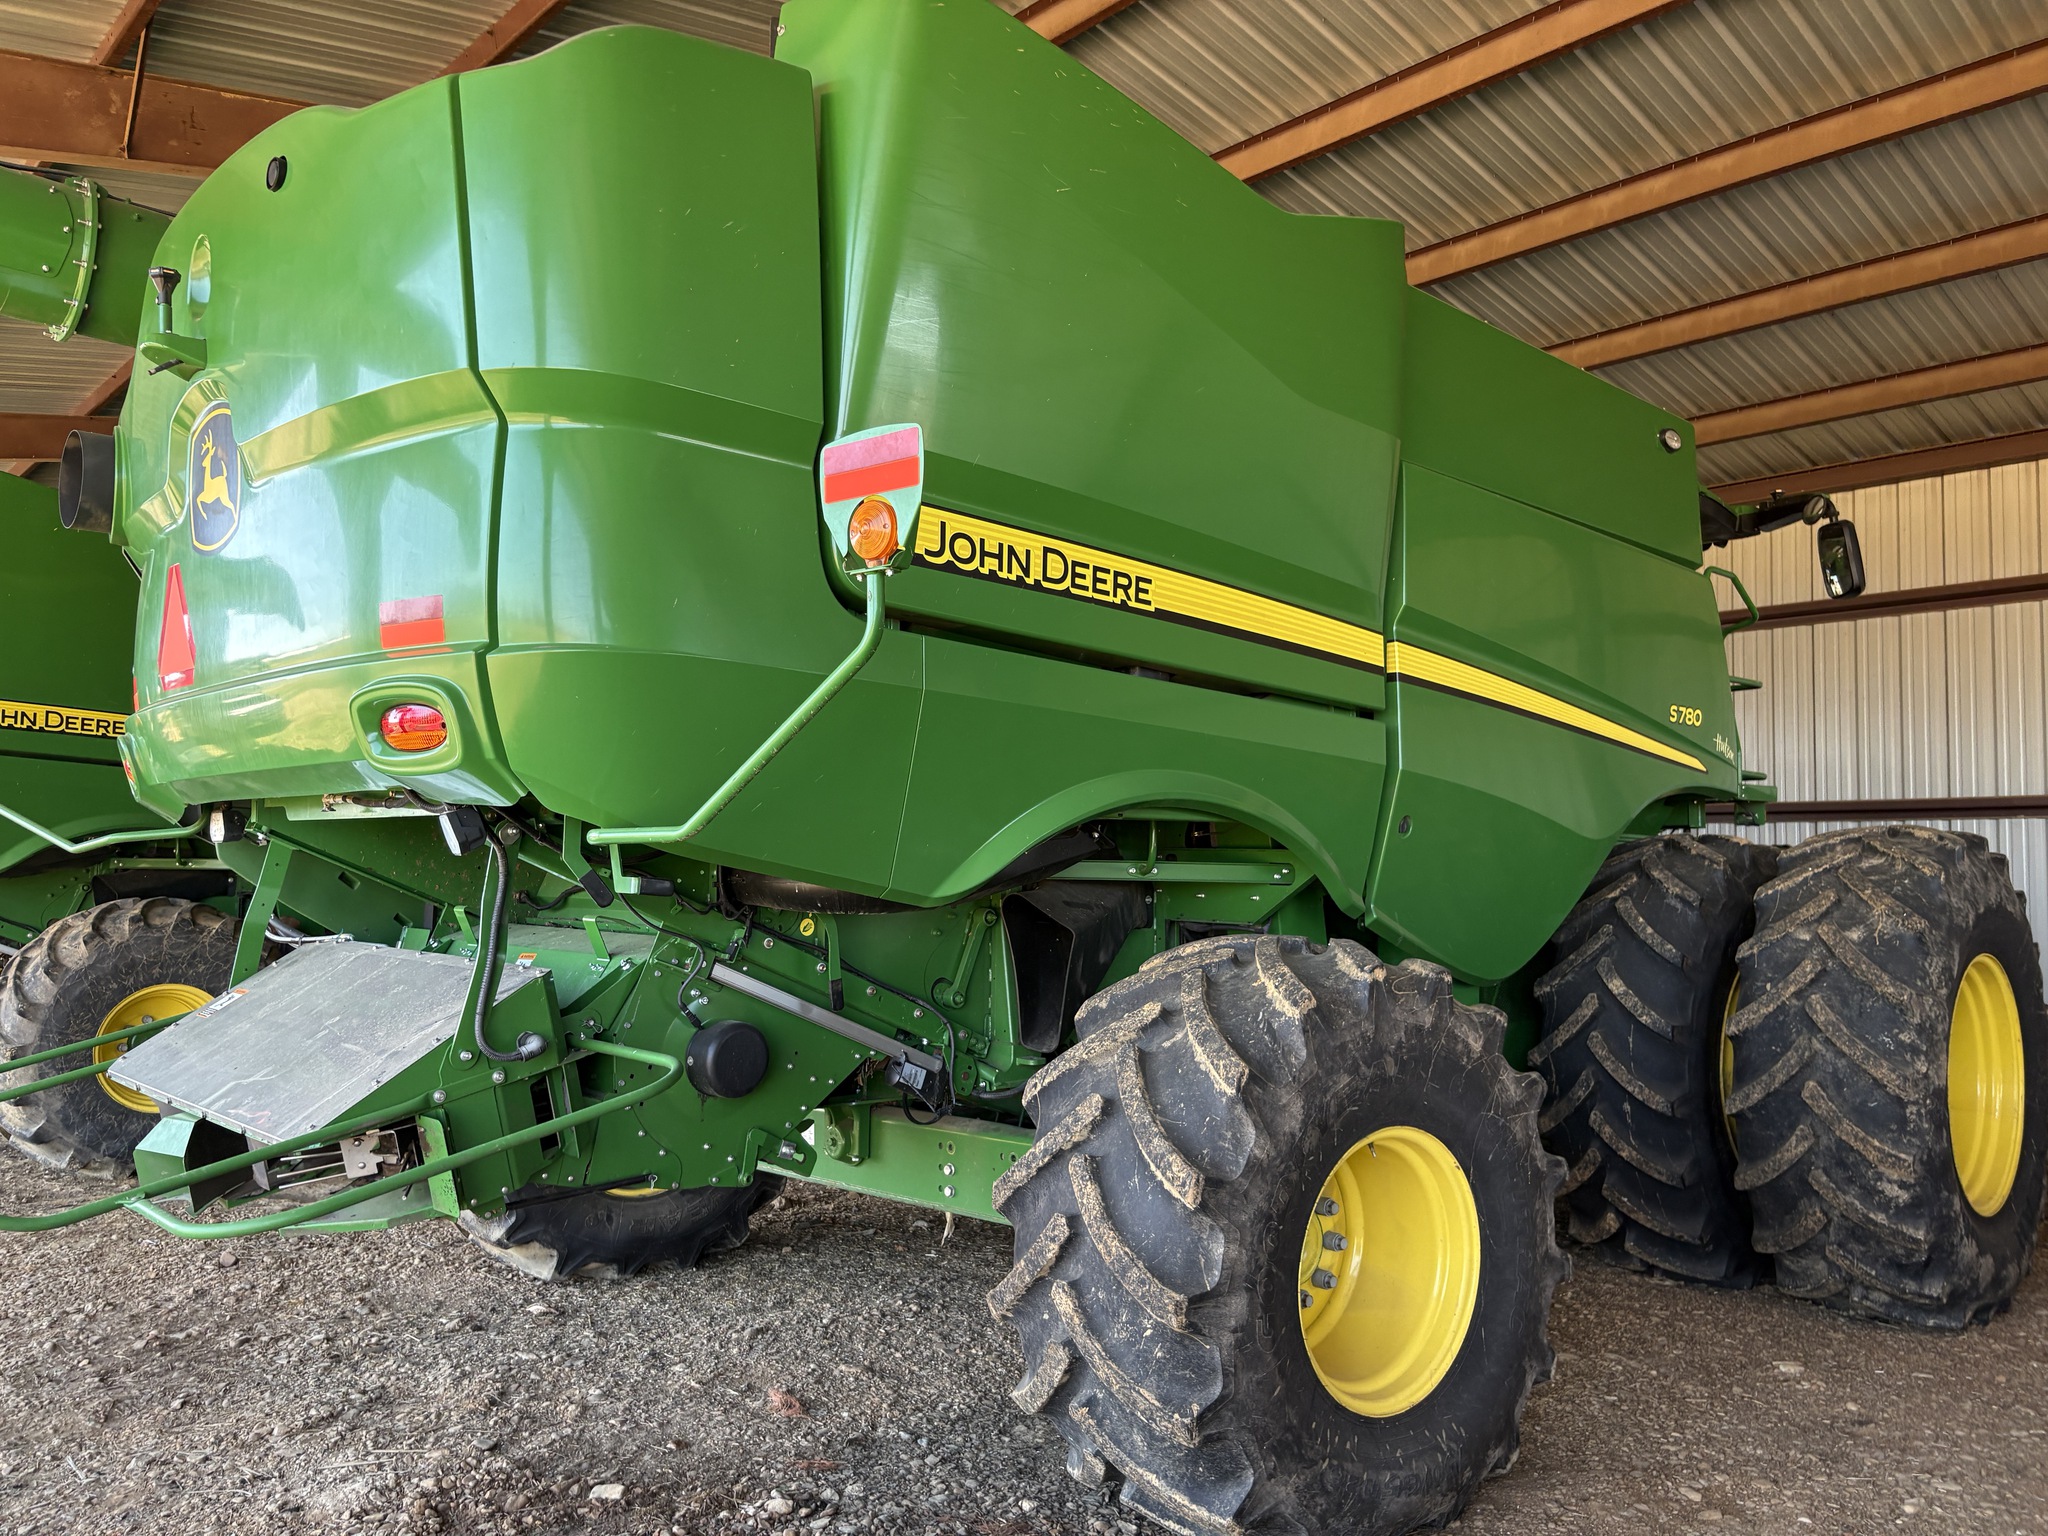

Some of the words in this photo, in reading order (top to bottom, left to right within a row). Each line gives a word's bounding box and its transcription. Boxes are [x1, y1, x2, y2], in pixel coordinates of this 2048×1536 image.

[924, 520, 1032, 579] JOHN
[1041, 545, 1153, 606] DEERE
[1, 708, 37, 727] HN
[45, 710, 126, 735] DEERE
[1669, 704, 1702, 727] S780
